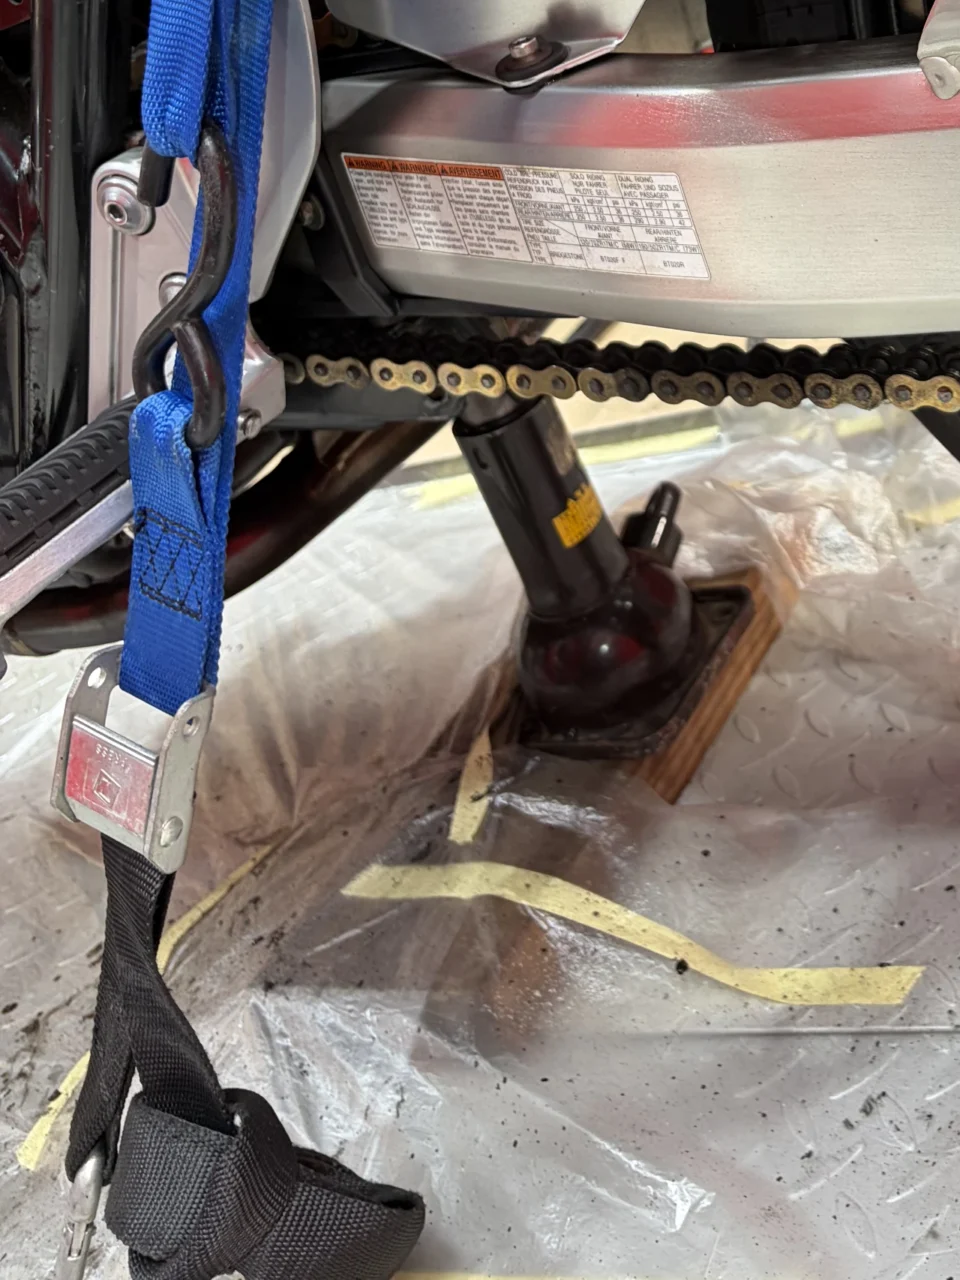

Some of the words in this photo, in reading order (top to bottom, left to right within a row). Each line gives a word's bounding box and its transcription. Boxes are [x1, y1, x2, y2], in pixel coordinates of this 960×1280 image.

[354, 159, 386, 169] WARNING
[397, 162, 436, 173] WARNUNG
[447, 165, 501, 178] AVERTISSEMENT
